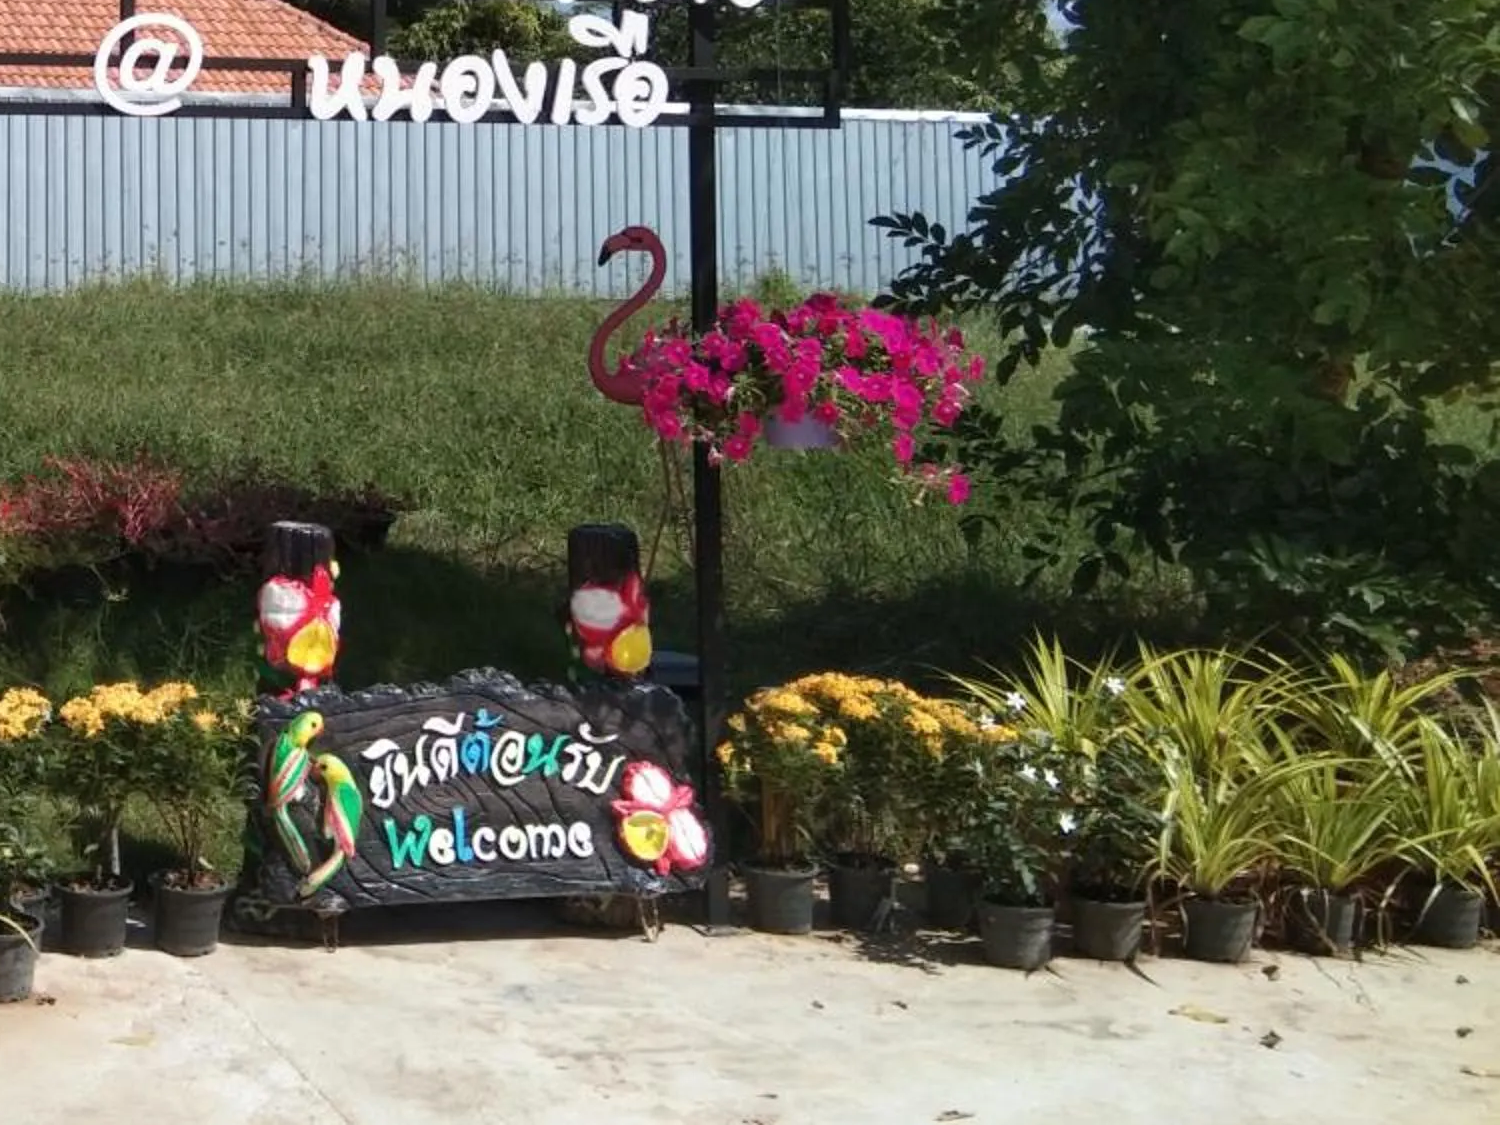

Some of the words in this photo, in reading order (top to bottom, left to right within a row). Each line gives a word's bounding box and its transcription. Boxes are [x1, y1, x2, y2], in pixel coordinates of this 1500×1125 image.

[308, 10, 669, 127] หนองเรือ
[361, 708, 625, 808] ยินดีต้อนรับ
[383, 806, 594, 870] Welcome
